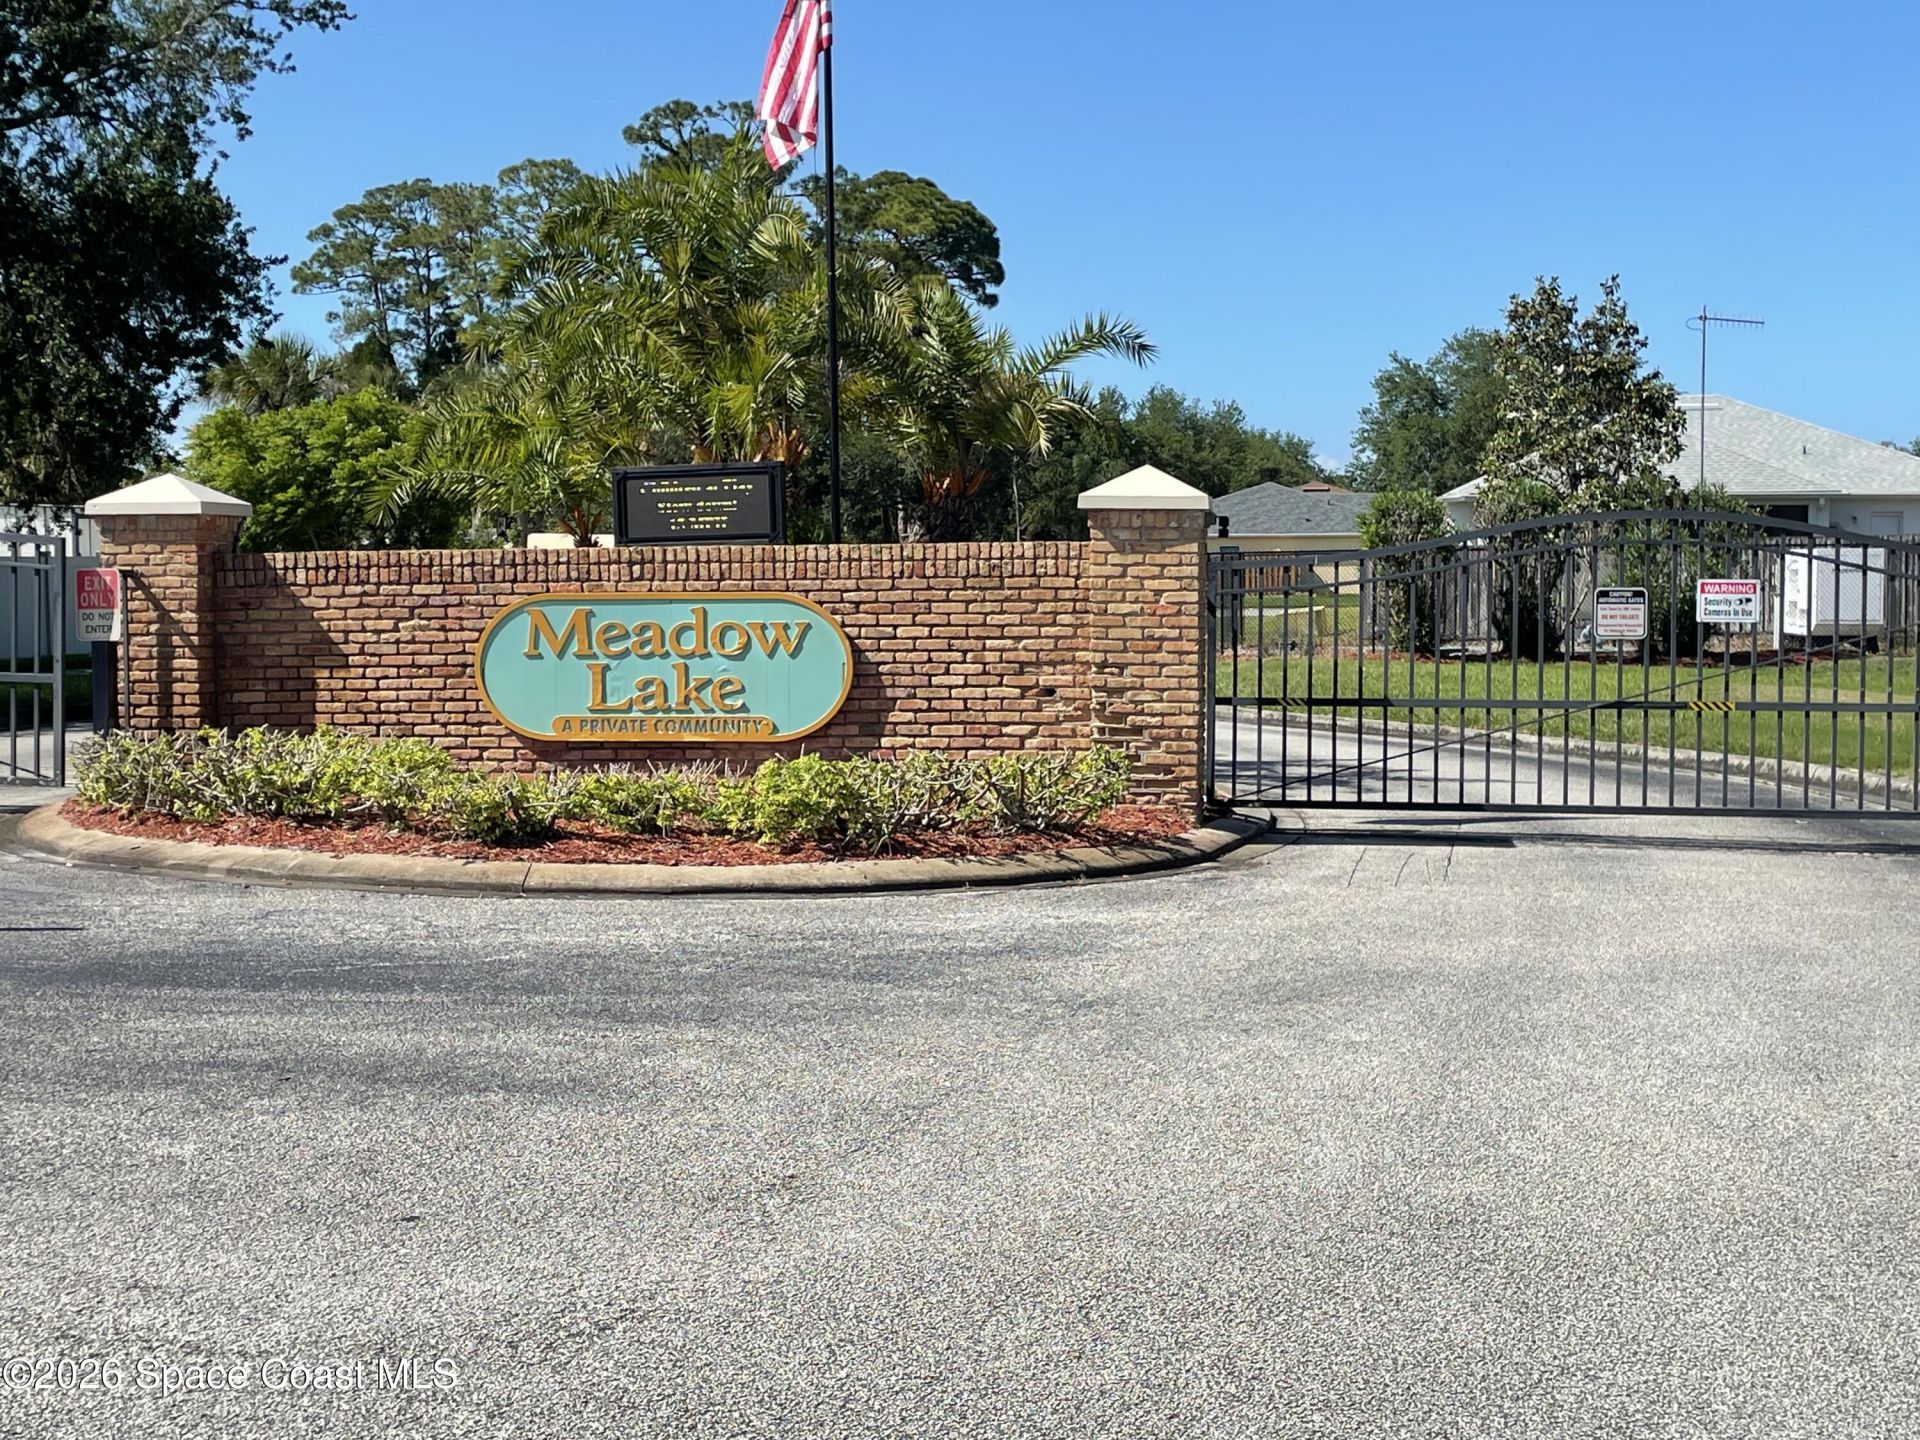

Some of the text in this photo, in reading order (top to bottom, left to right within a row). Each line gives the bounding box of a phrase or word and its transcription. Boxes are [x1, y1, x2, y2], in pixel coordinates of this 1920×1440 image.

[84, 576, 112, 591] EXIT
[1704, 584, 1754, 593] WARNING
[80, 592, 115, 607] ONLY
[1704, 597, 1732, 607] Security
[82, 612, 114, 621] DO NOT
[1704, 608, 1731, 617] Cameras
[1741, 608, 1753, 617] Use
[85, 625, 112, 633] ENTER
[523, 606, 813, 661] Meadow
[586, 661, 750, 714] Lake
[561, 718, 764, 735] A PRIVATE COMMUNITY
